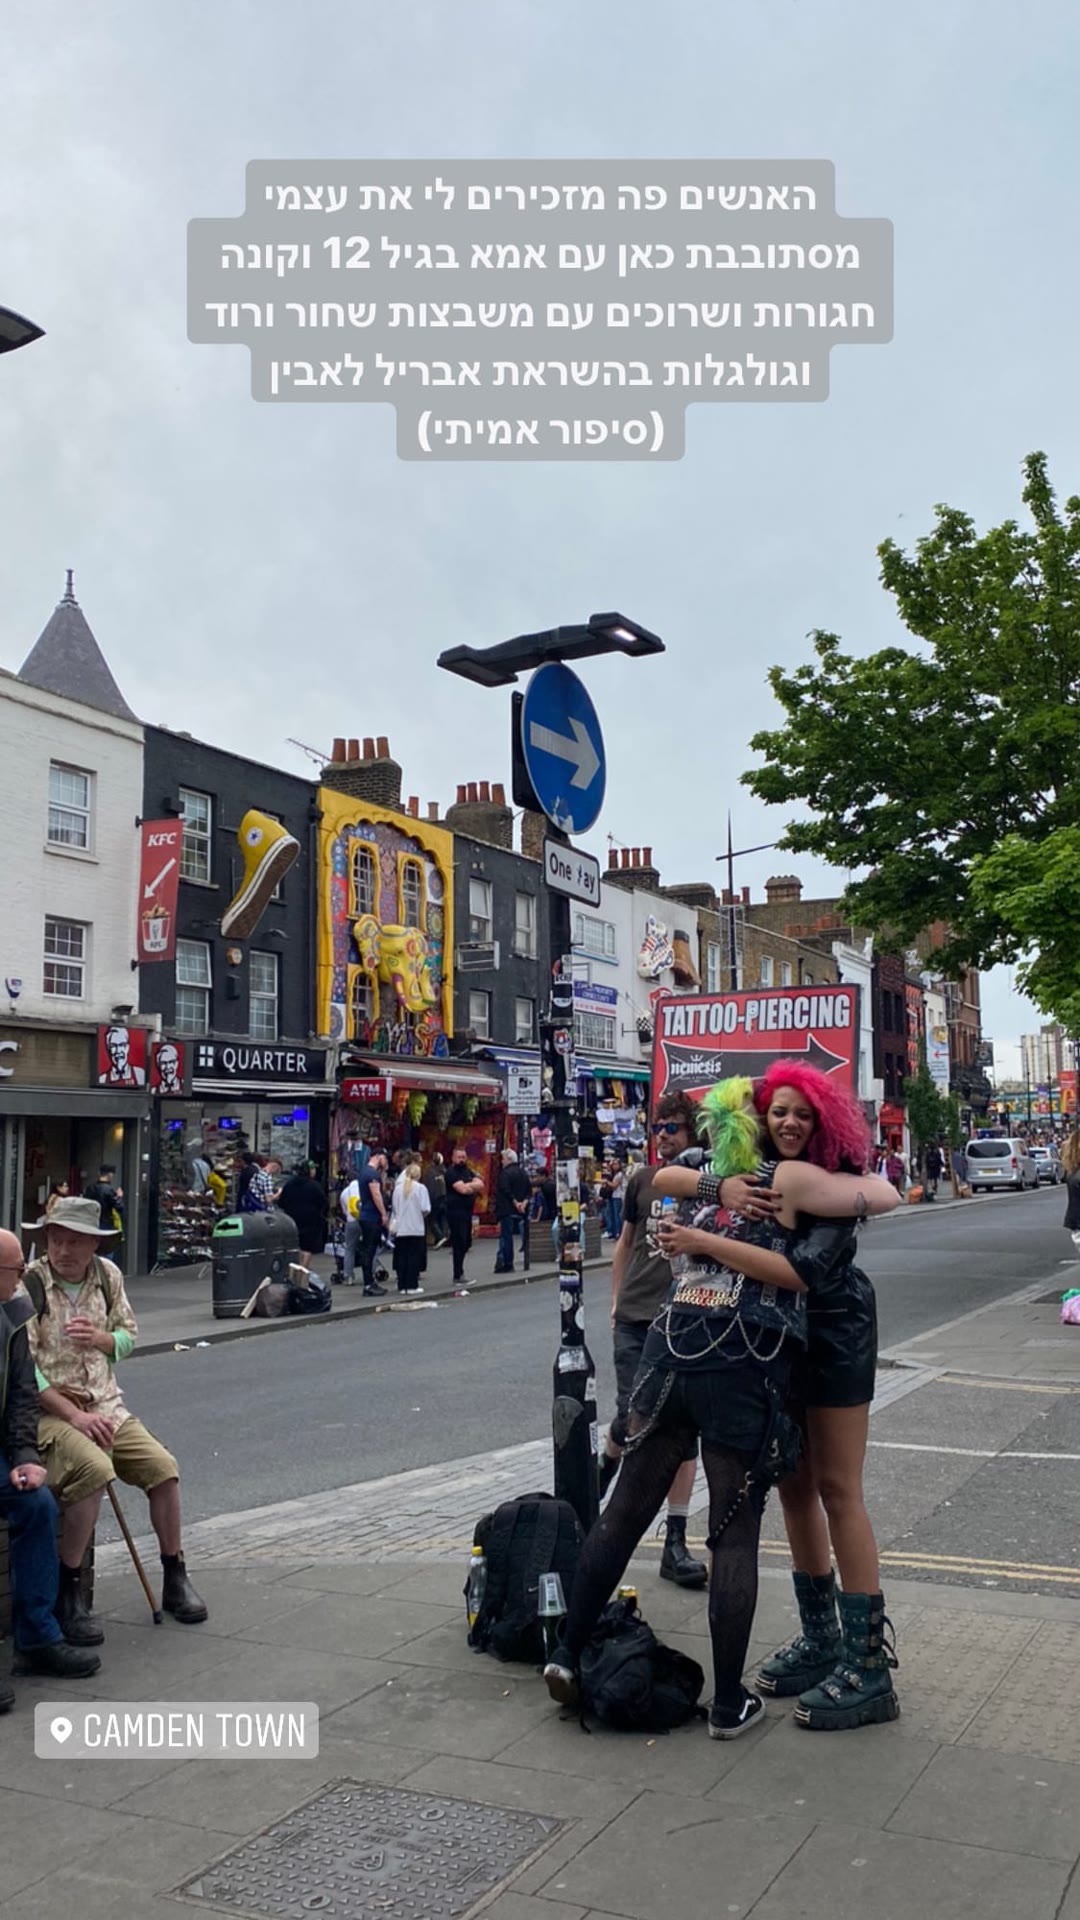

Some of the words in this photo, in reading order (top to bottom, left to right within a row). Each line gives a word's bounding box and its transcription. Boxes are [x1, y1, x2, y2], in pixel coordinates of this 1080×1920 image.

[147, 832, 177, 847] KFC
[549, 852, 572, 881] One
[662, 994, 850, 1036] TATTOO-PIERCING
[222, 1047, 308, 1073] QUARTER
[670, 1059, 722, 1076] nemesis
[350, 1083, 380, 1098] ATM
